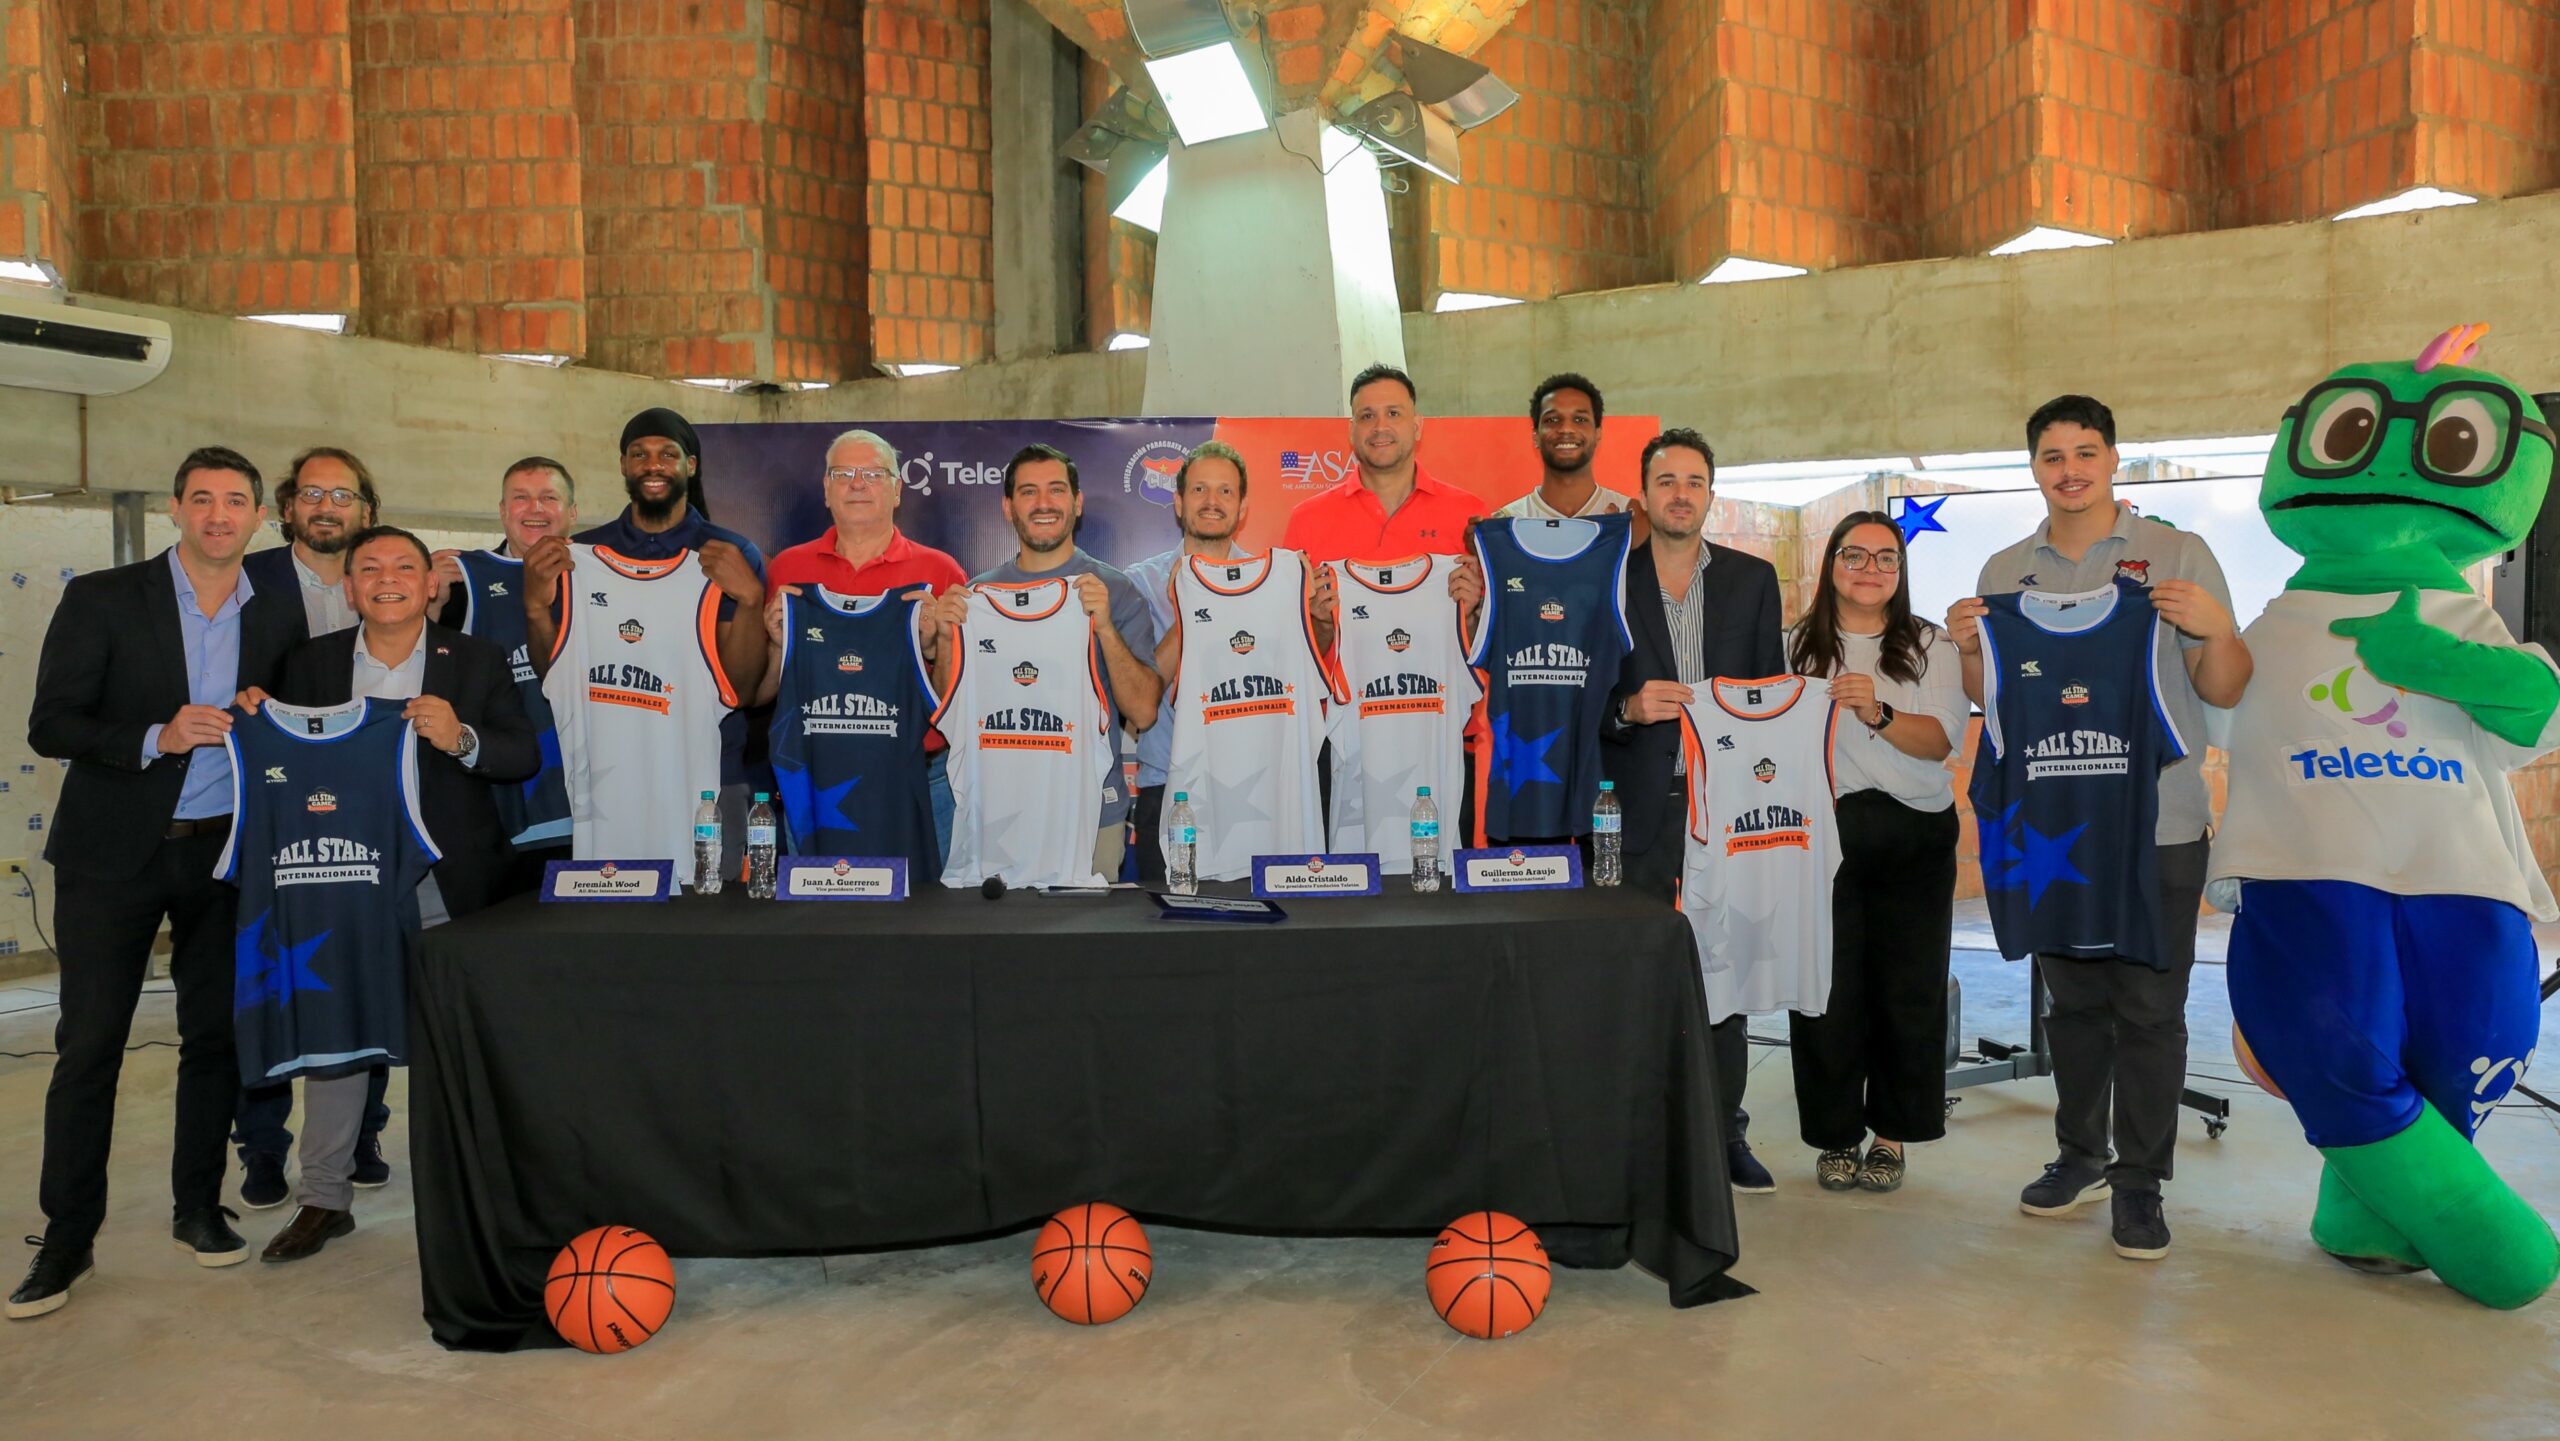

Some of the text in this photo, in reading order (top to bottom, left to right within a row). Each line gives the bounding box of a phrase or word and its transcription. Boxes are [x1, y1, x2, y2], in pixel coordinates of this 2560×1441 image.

[1146, 440, 1182, 451] PARAGUAYA
[1514, 643, 1584, 667] ALL STAR
[589, 664, 662, 693] ALL STAR
[1211, 675, 1283, 702] ALL STAR
[1365, 673, 1438, 698] ALL STAR
[811, 693, 888, 717] ALL STAR
[1209, 703, 1287, 717] INTERNACIONALES
[984, 707, 1063, 732] ALL STAR
[982, 737, 1066, 747] INTERNACIONALES
[2036, 730, 2125, 757] ALL STAR
[2035, 763, 2126, 772] INTERNACIONALES
[2290, 746, 2465, 784] Teletón
[1734, 805, 1803, 833] ALL STAR
[279, 837, 369, 866] ALL STAR
[277, 869, 372, 881] INTERNACIONALES
[802, 879, 823, 887] Juan
[1285, 875, 1348, 883] Aldo Cristaldo
[1481, 867, 1556, 877] Guillermo Araujo
[573, 880, 641, 889] Jeremiah Wood
